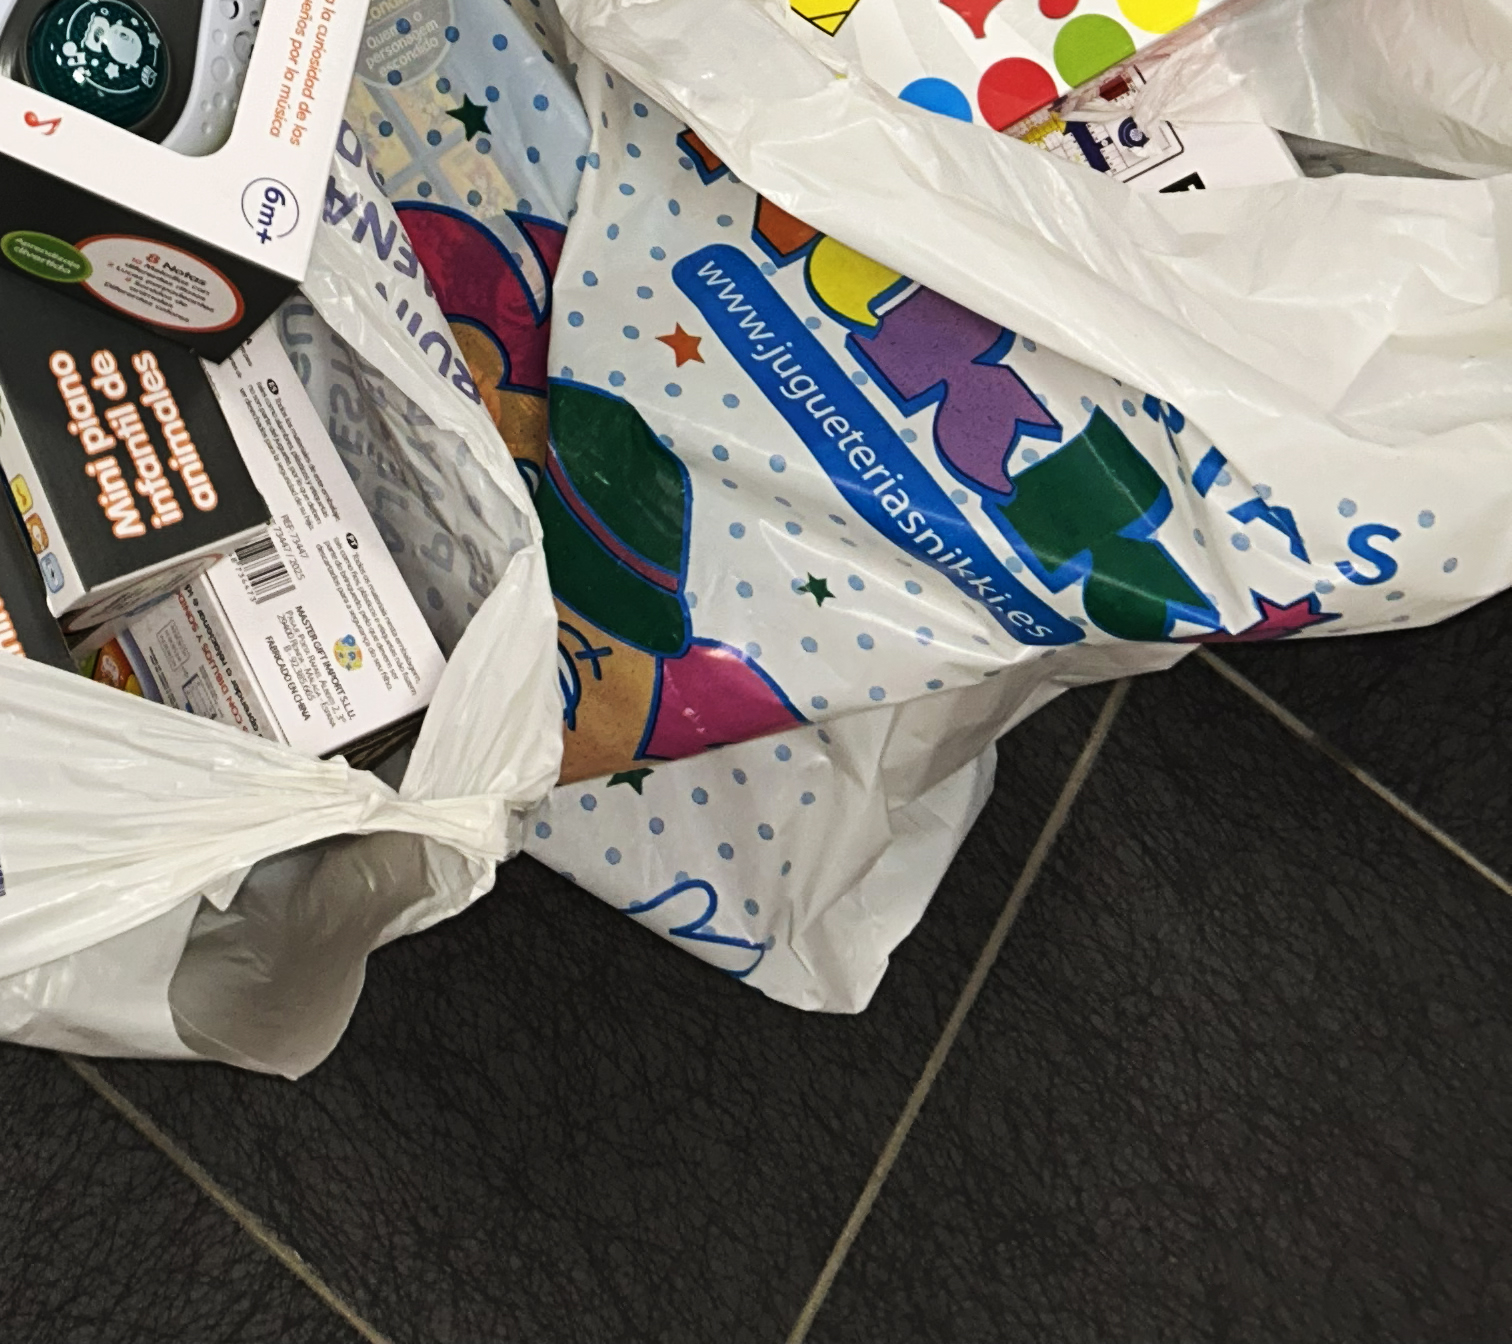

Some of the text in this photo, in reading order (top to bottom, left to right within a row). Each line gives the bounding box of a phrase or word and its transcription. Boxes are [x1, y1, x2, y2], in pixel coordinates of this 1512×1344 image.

[320, 5, 336, 22] la
[283, 65, 300, 82] la
[289, 37, 302, 66] por
[302, 23, 328, 100] curiosidad
[269, 83, 292, 138] música
[289, 123, 308, 147] los
[296, 100, 312, 121] de
[257, 185, 287, 245] 6m+
[49, 349, 146, 541] Mini piano
[90, 348, 185, 530] infantil de
[131, 349, 219, 512] animales
[695, 257, 1056, 645] www.jugueteriasnikki.es
[265, 635, 293, 685] FABRICADO
